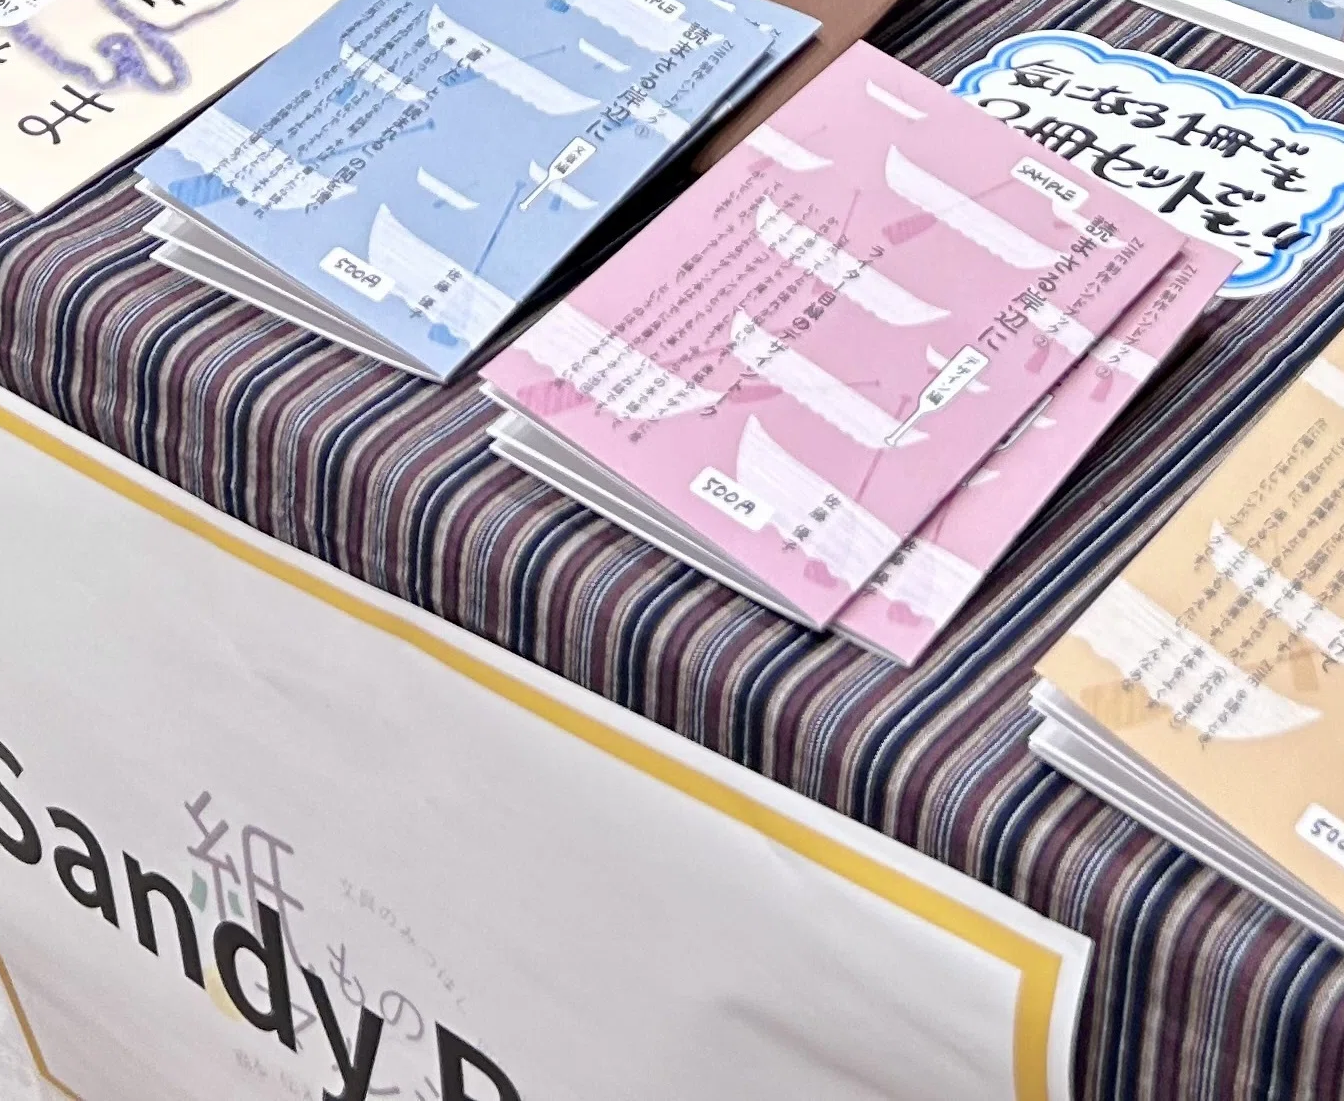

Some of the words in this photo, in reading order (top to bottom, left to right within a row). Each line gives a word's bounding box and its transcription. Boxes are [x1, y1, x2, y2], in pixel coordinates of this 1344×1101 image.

[582, 19, 714, 144] 読まさる岸辺に
[1010, 57, 1312, 195] 気になる1冊でも
[1015, 160, 1078, 205] SAMPLE
[331, 252, 382, 291] 500円
[973, 214, 1120, 354] 読まさる岸辺に
[700, 473, 759, 519] 500円
